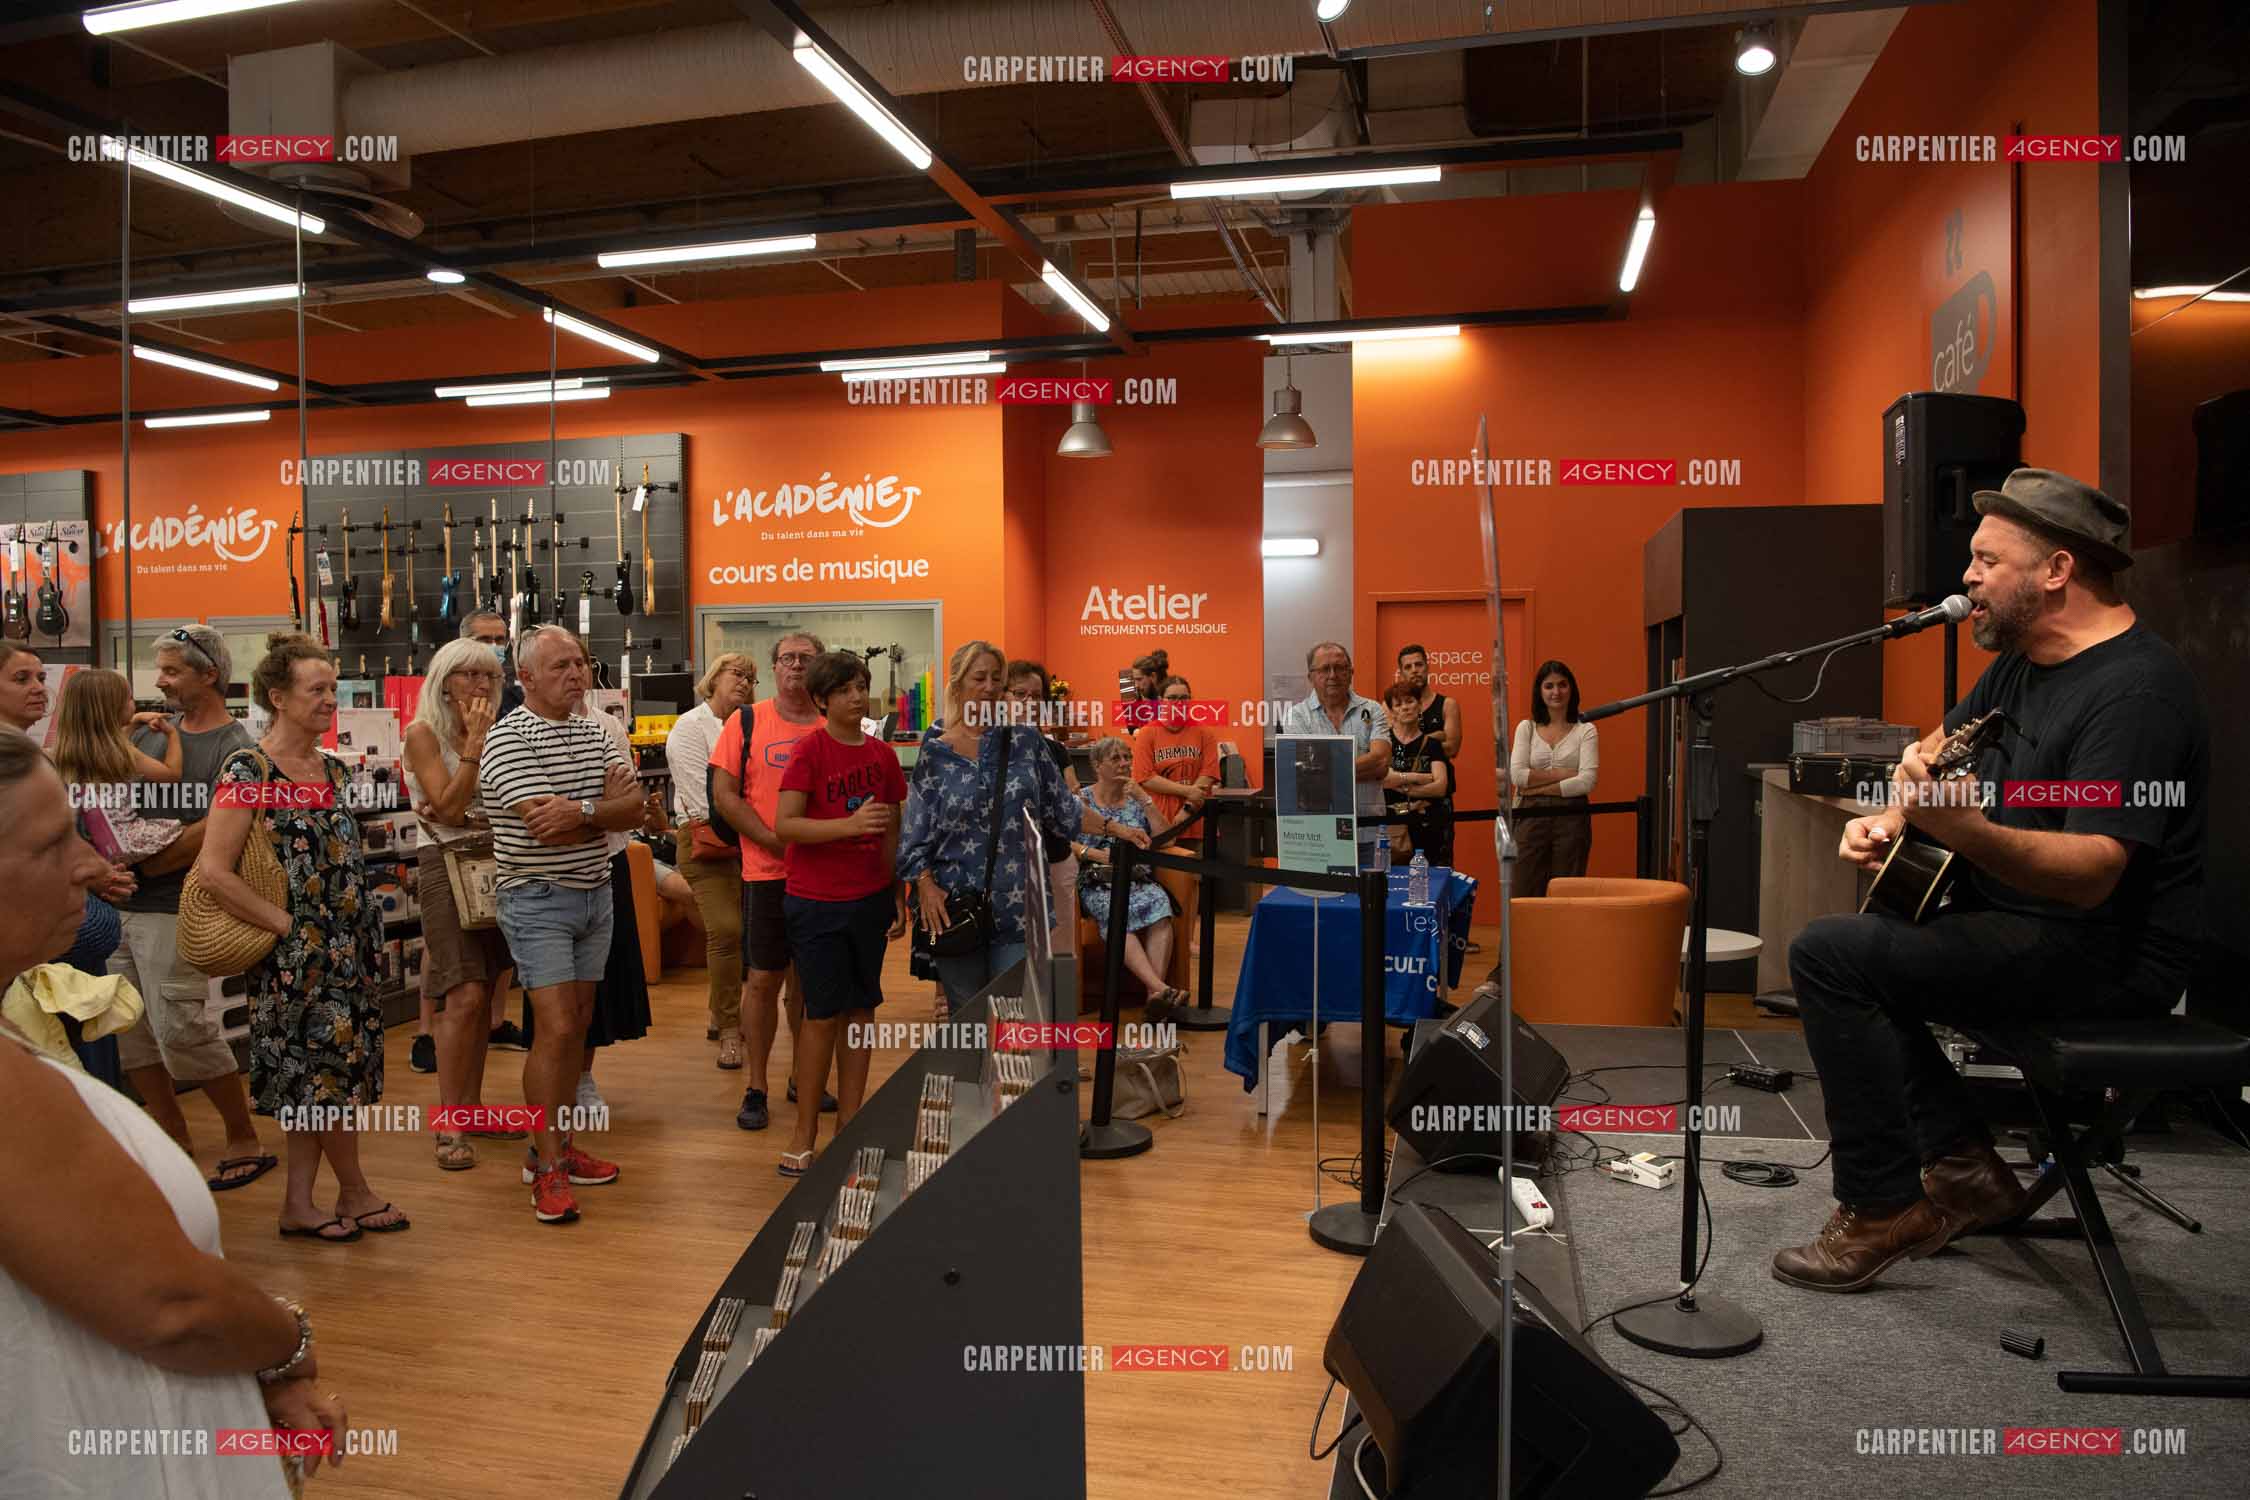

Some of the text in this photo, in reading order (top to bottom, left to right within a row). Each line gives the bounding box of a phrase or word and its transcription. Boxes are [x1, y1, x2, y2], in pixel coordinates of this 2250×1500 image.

[1933, 311, 1975, 393] café
[761, 528, 864, 540] Du talent dans ma vie
[708, 553, 929, 585] cours de musique
[1081, 584, 1208, 621] Atelier
[1080, 623, 1228, 635] INSTRUMENTS DE MUSIQUE
